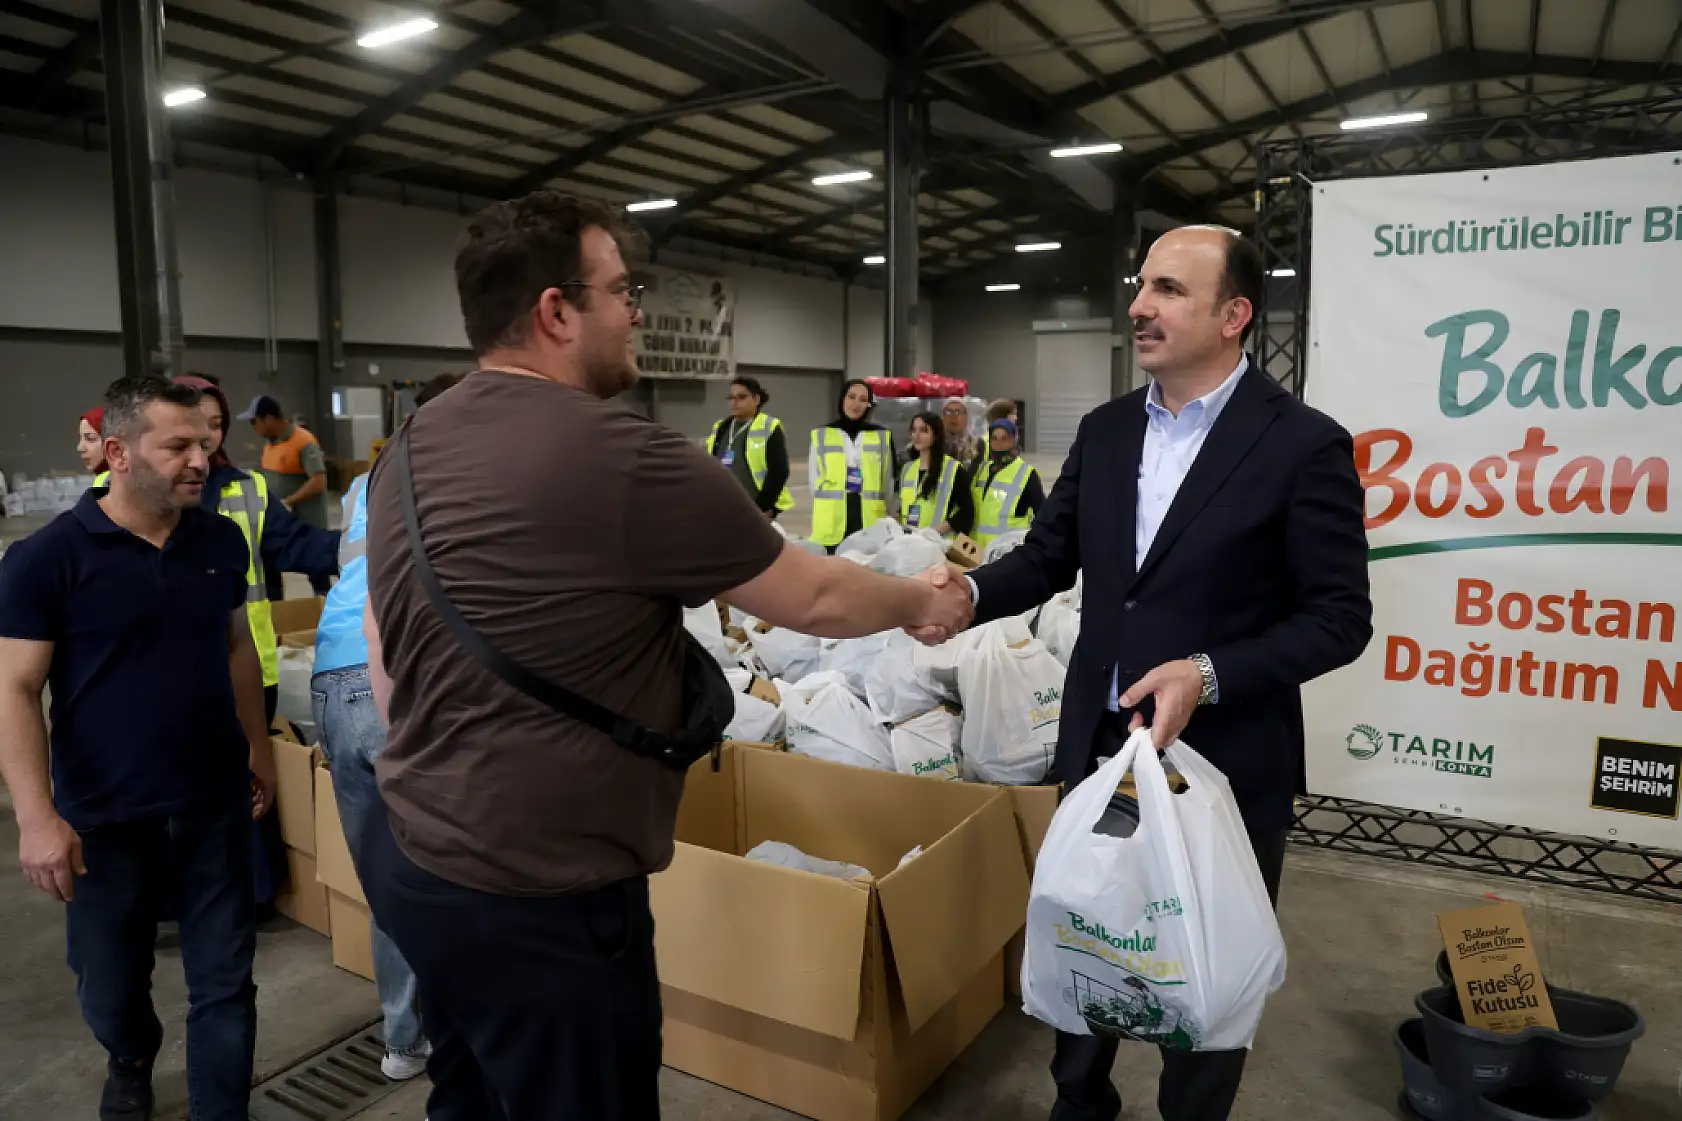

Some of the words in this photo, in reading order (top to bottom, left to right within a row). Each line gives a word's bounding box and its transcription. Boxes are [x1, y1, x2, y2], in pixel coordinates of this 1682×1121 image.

[1374, 210, 1632, 257] Sürdürülebilir
[1353, 427, 1669, 530] Bostan
[1455, 577, 1675, 643] Bostan
[1384, 635, 1619, 705] Dağıtım
[1387, 731, 1494, 764] TARIM
[1436, 760, 1491, 778] KONYA
[1466, 978, 1508, 997] Fide
[1472, 995, 1539, 1015] Kutusu
